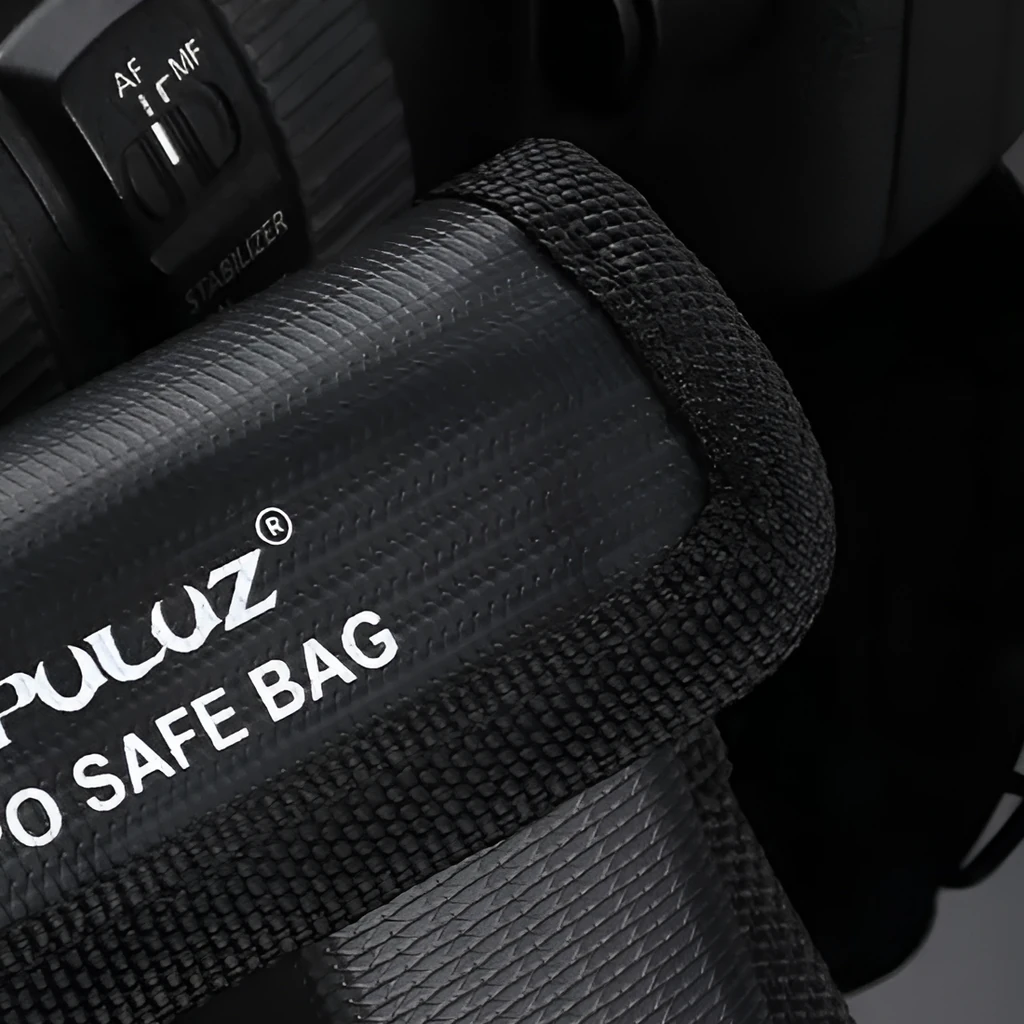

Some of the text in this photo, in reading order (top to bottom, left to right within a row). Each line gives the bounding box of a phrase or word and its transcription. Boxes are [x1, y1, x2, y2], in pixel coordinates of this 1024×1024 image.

[114, 57, 142, 98] AF
[167, 38, 200, 81] MF
[184, 210, 288, 314] STABILIZER
[72, 687, 250, 812] SAFE
[247, 610, 399, 723] BAG
